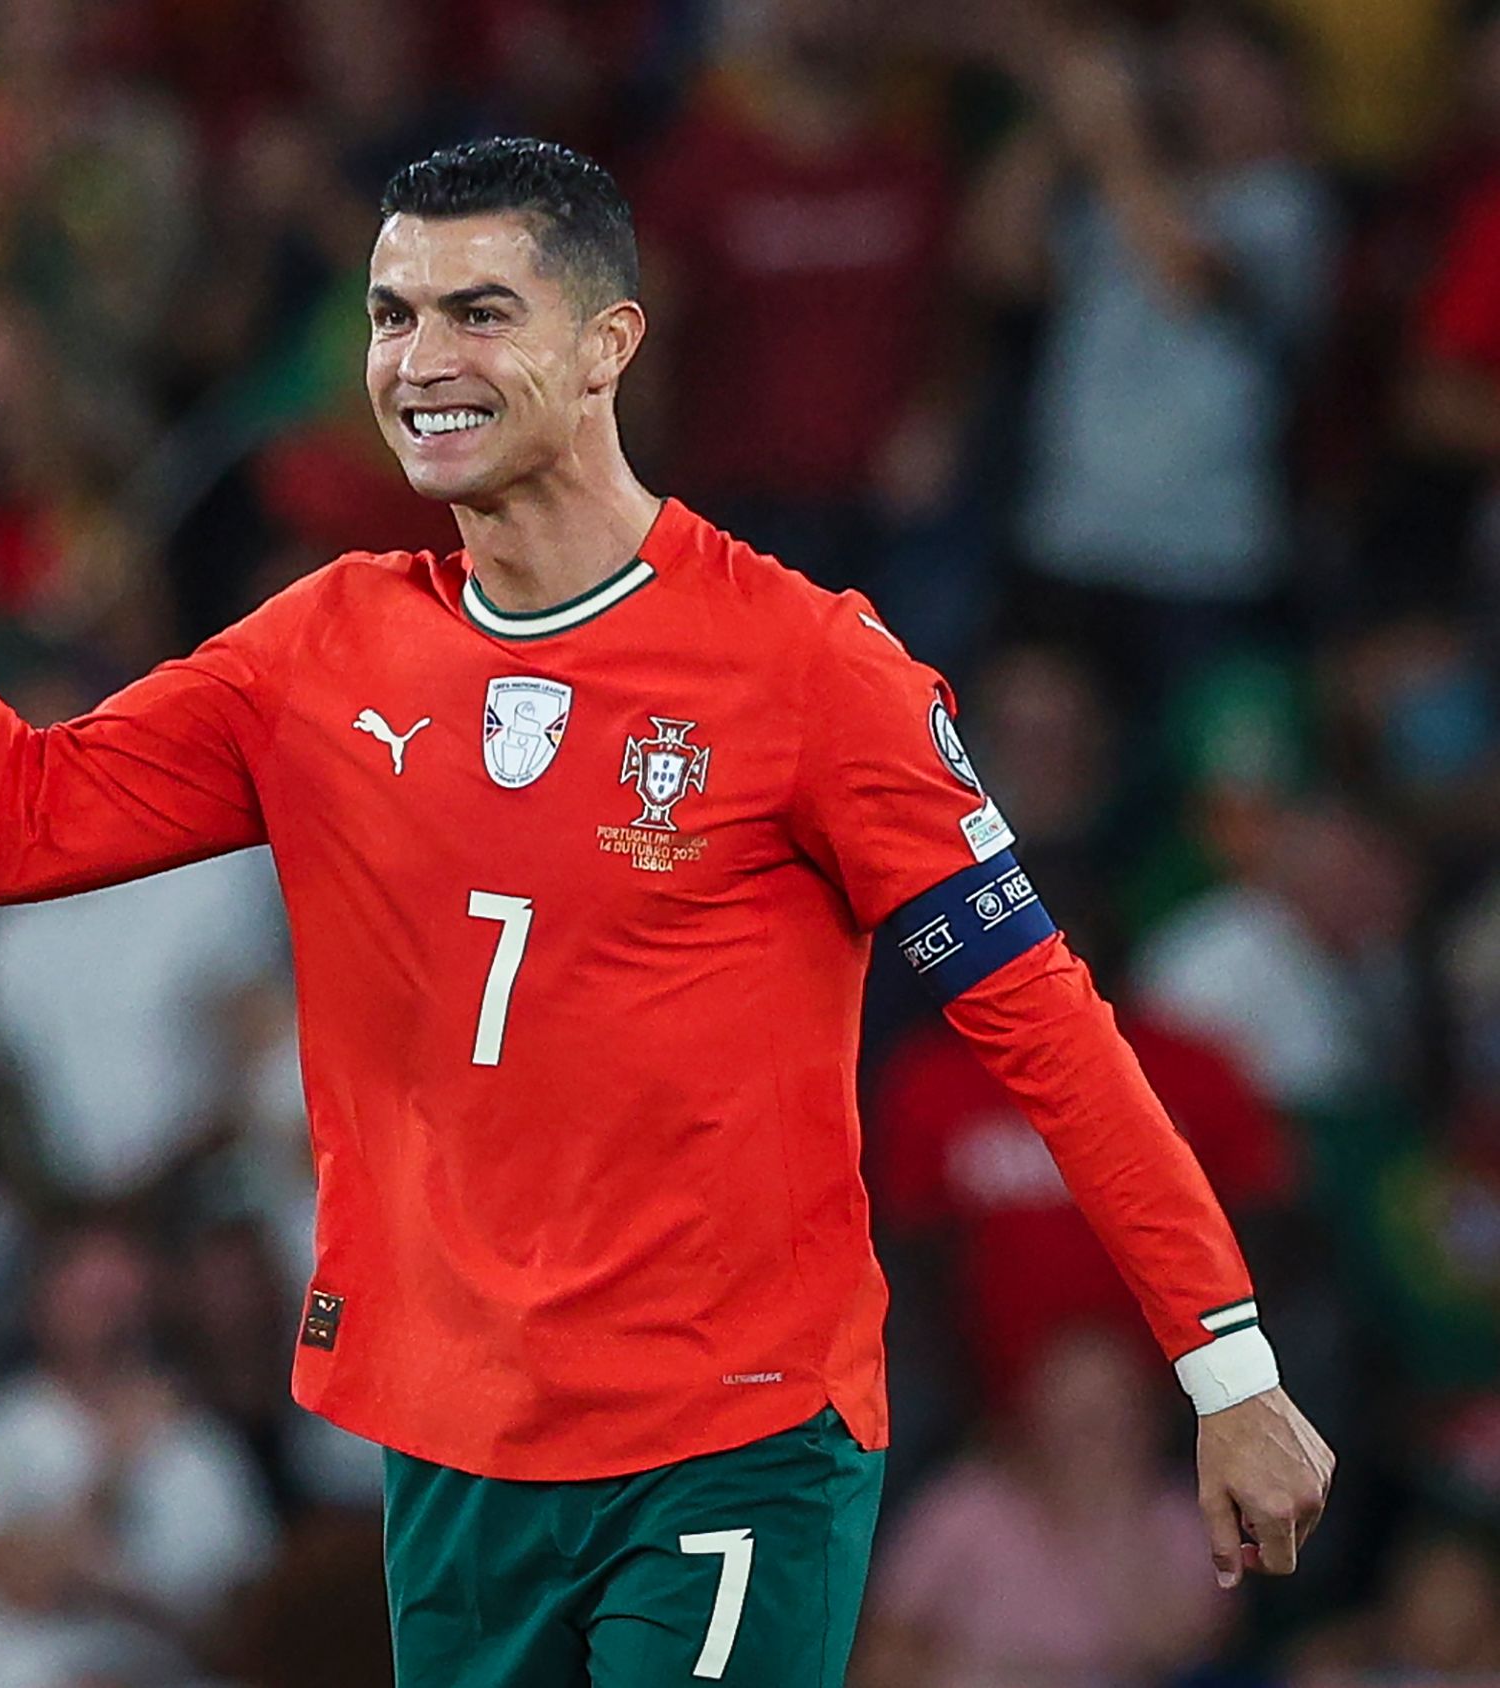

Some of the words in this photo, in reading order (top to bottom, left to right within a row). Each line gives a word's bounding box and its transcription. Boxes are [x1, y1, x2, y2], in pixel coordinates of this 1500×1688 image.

[632, 855, 673, 873] LISBOA
[468, 890, 534, 1066] 7
[679, 1528, 754, 1679] 7
